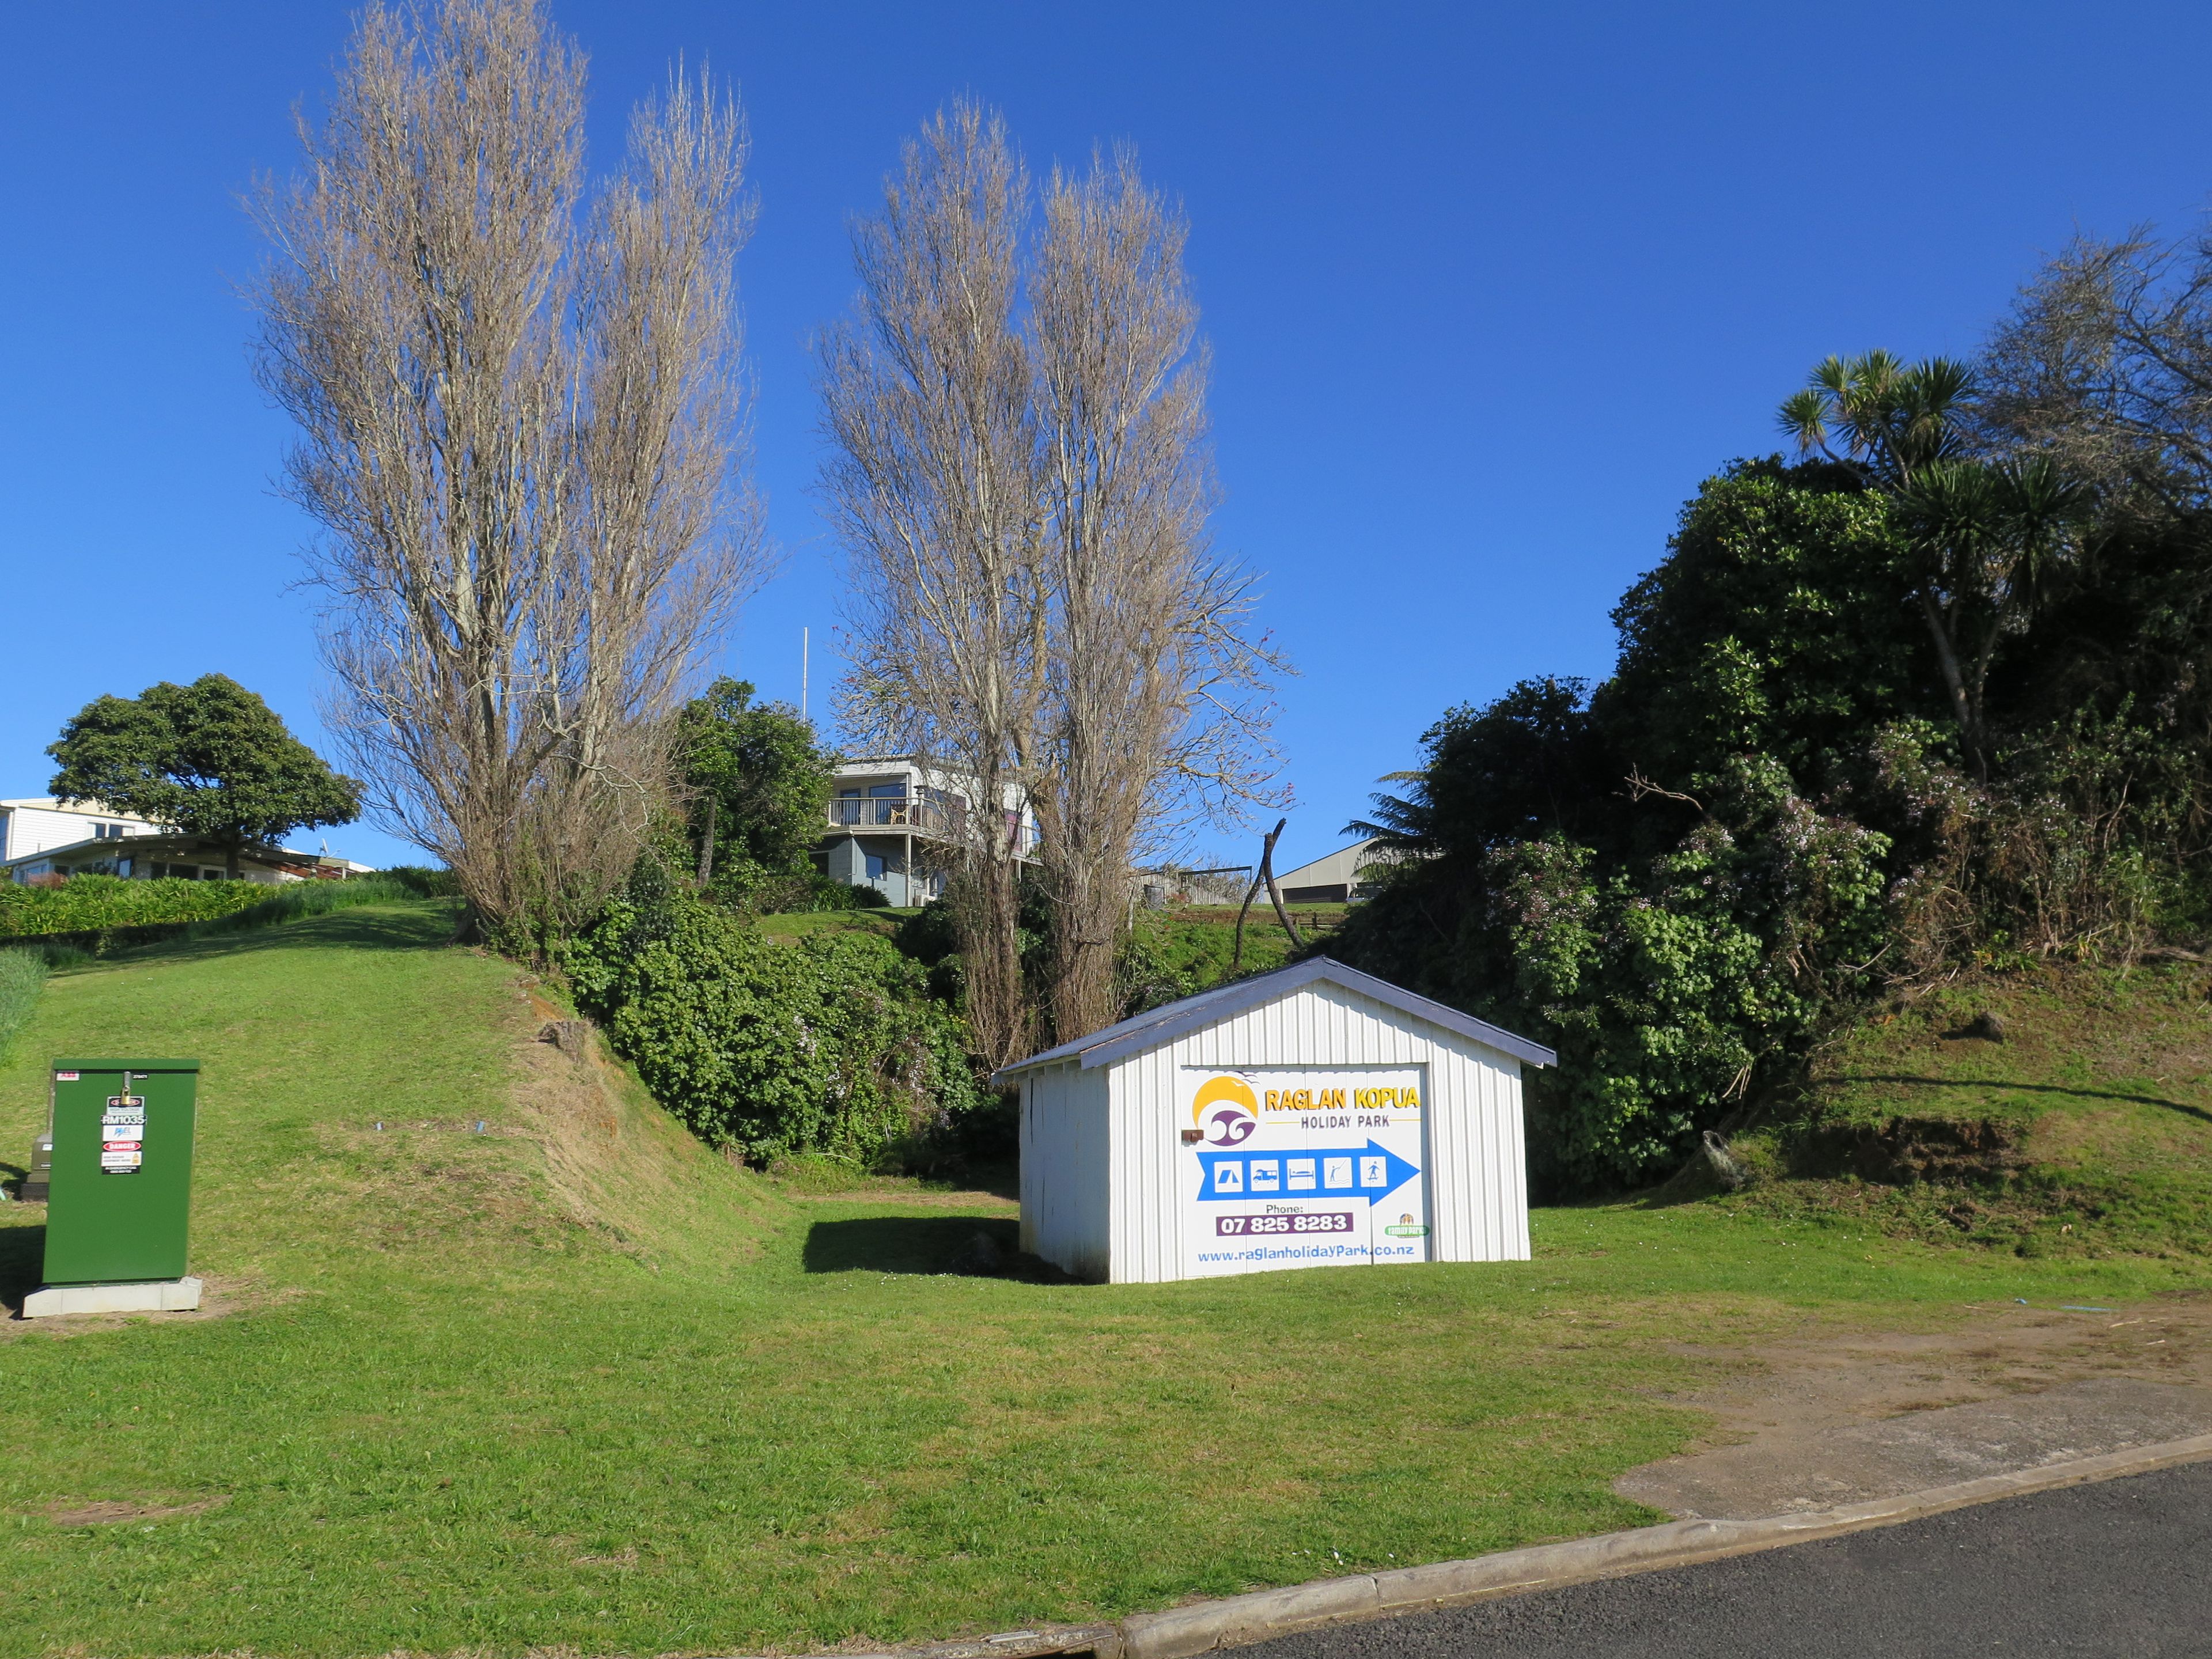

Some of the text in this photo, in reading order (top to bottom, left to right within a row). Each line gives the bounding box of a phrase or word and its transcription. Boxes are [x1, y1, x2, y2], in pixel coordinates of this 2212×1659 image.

[1265, 1087, 1421, 1111] RAGLAN KOPUA
[103, 1115, 145, 1124] RM1035
[1301, 1115, 1390, 1129] HOLIDAY PARK
[1266, 1205, 1304, 1214] Phone:
[1221, 1215, 1347, 1233] 07 825 8283
